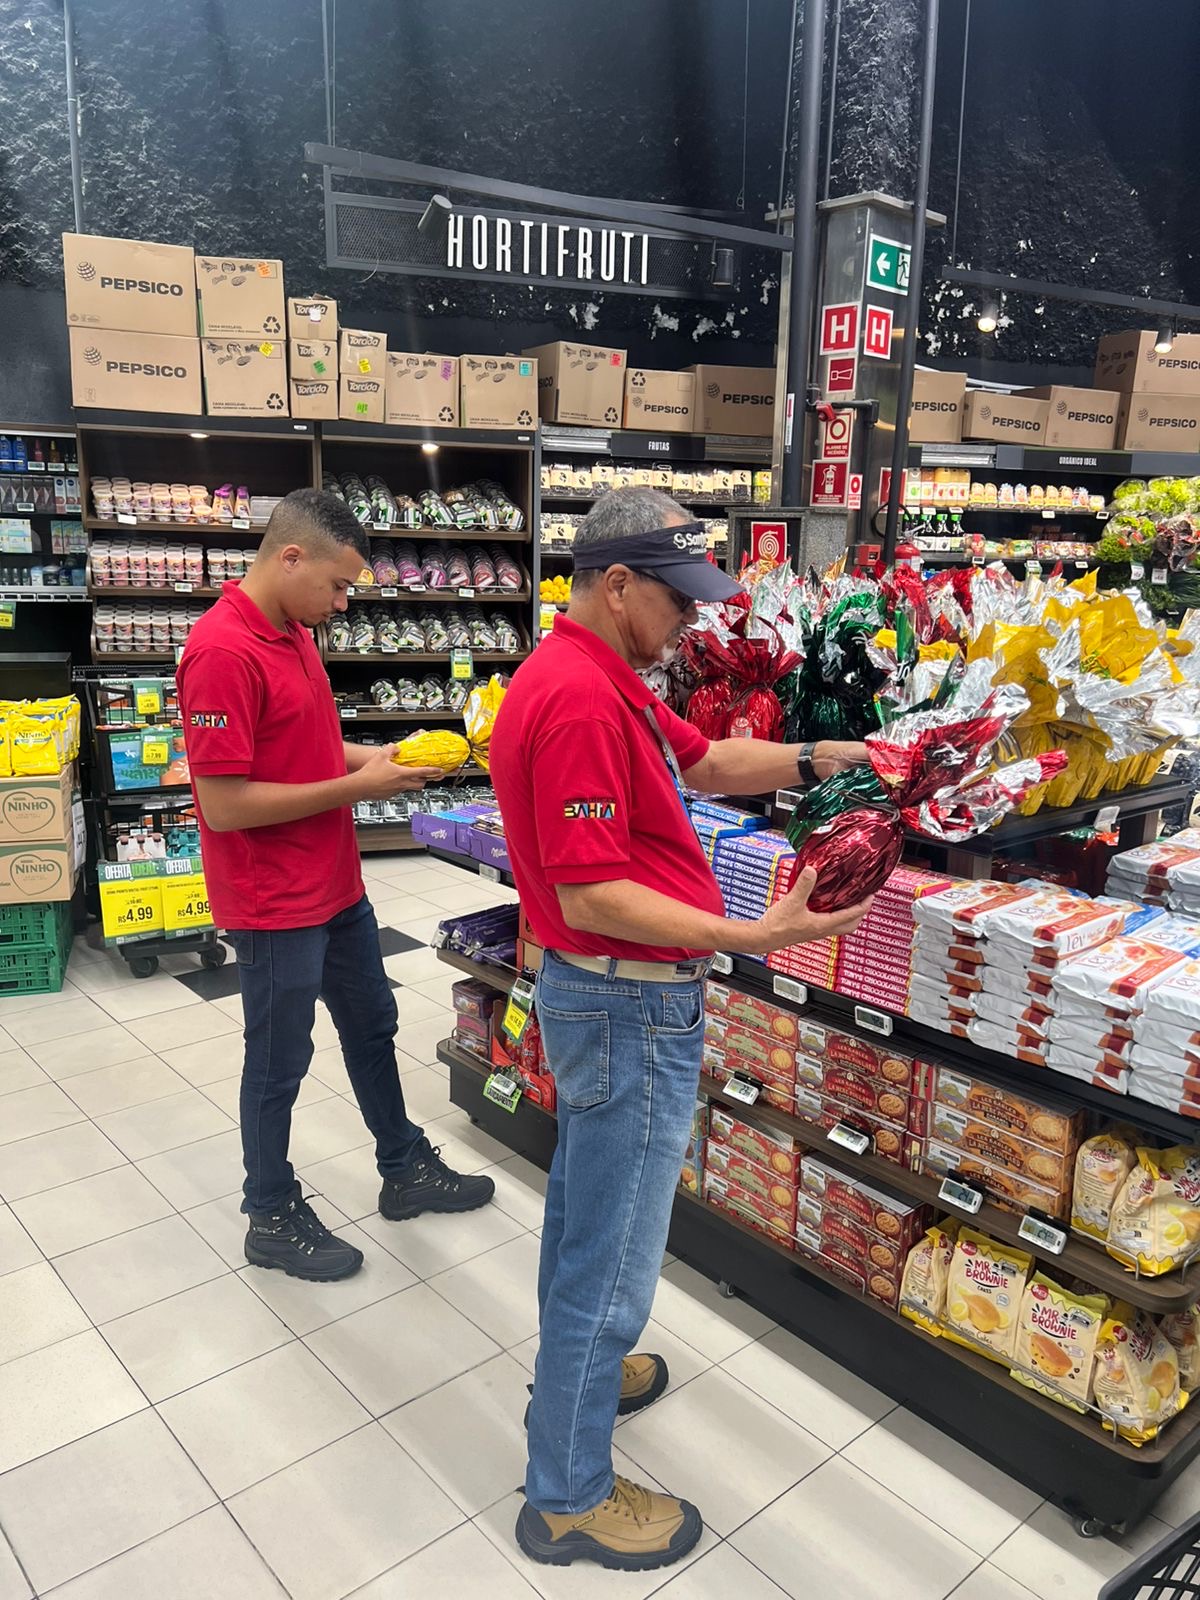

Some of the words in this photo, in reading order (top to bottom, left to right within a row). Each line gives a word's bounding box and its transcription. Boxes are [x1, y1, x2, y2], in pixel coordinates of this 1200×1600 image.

[447, 213, 649, 285] HORTIFRUTI
[100, 276, 183, 297] PEPSICO
[830, 313, 850, 344] H
[871, 316, 886, 348] H
[106, 361, 187, 379] PEPSICO
[297, 384, 327, 394] Torcida
[349, 381, 379, 392] Torcida
[723, 393, 774, 405] PEPSIC
[644, 404, 688, 414] PEPSICO
[1068, 411, 1114, 425] PEPSICO
[992, 416, 1041, 431] PEPSICO
[1149, 417, 1197, 428] PEPSICO
[648, 441, 670, 451] FRUTAS
[1083, 457, 1097, 466] IDEAL
[8, 801, 48, 812] NINHO
[564, 802, 616, 818] BAHIA
[15, 863, 55, 874] NINHO
[105, 863, 132, 880] OFERTA
[166, 858, 192, 874] OFERTA
[865, 949, 910, 967] CHOCOLONELY
[865, 958, 910, 976] CHOCOLONELY
[789, 969, 828, 987] CHOCOLONELY
[790, 961, 829, 979] CHOCOLONELY
[864, 967, 906, 985] CHOCOLONELY
[862, 984, 905, 1003] CHOCOLONELY
[864, 976, 909, 994] CHOCOLONELY
[861, 993, 905, 1012] CHOCOLONELY
[965, 1267, 1009, 1289] BROWNIE
[1031, 1312, 1077, 1340] BROWNIE
